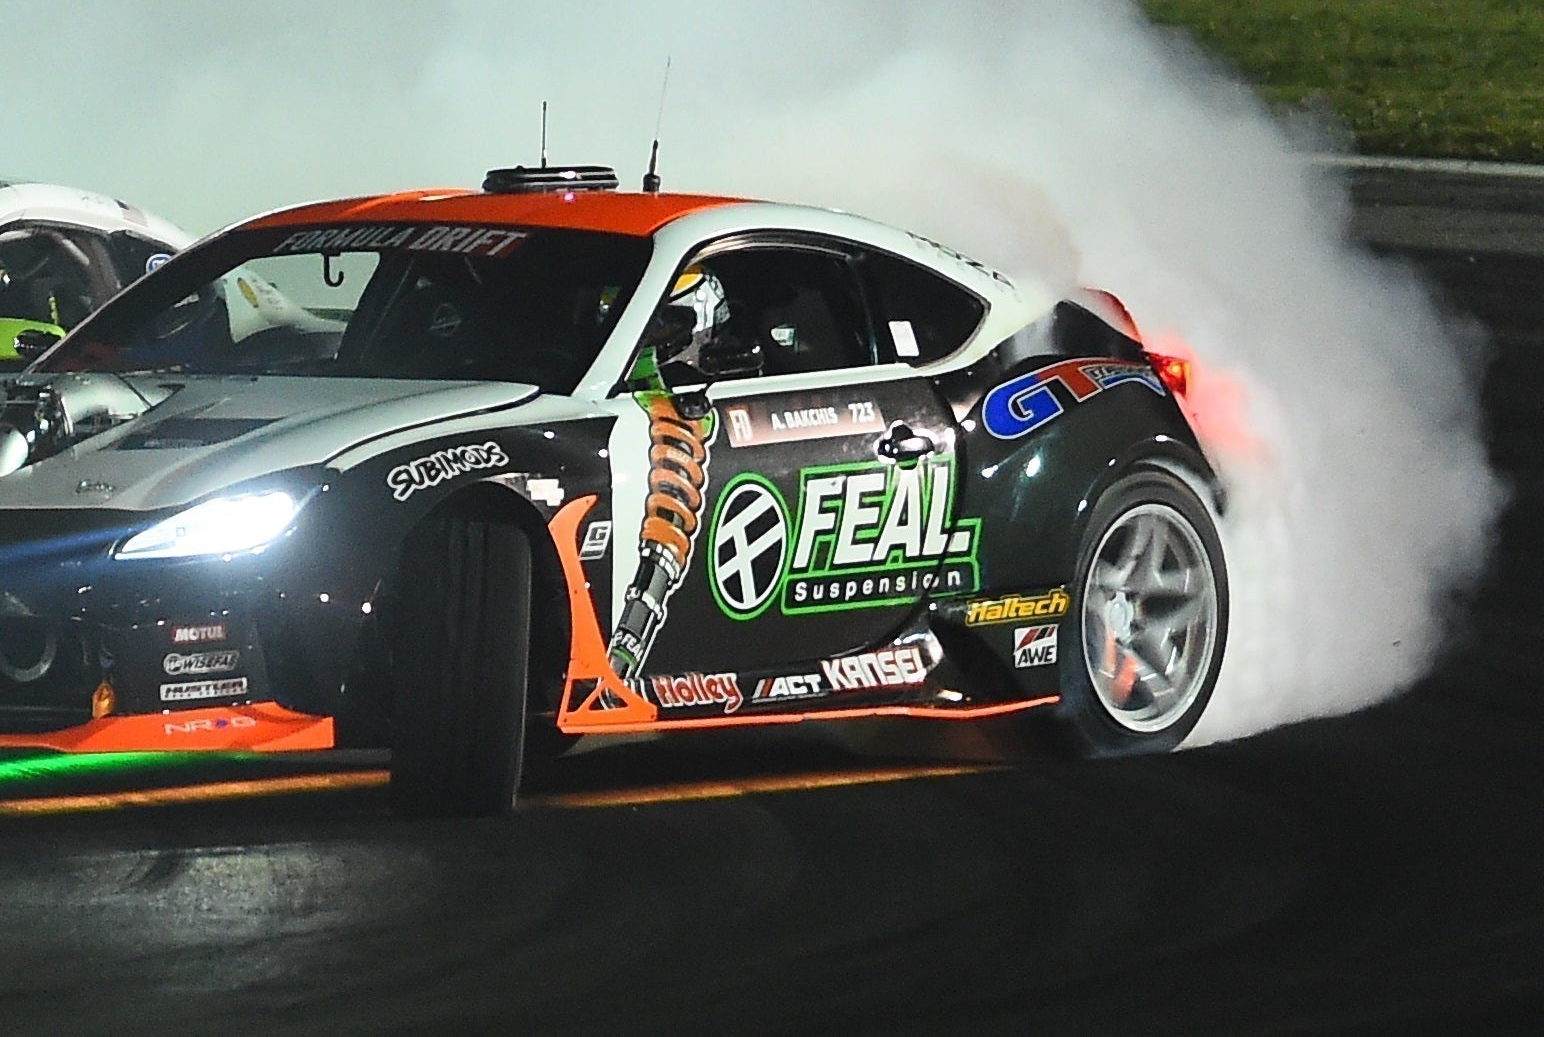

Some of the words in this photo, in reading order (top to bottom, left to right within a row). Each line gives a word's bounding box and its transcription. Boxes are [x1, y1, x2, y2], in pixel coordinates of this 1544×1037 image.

[272, 226, 416, 253] FORMULA
[409, 226, 529, 256] DRIFT
[847, 401, 876, 424] 723
[981, 356, 1148, 440] GT
[792, 466, 971, 568] FEAL
[793, 569, 961, 602] Suspension
[966, 591, 1068, 624] Haltech
[174, 625, 227, 643] MOTUL
[820, 646, 928, 691] KANSEI
[1017, 644, 1056, 666] AWE
[652, 672, 743, 713] Holley
